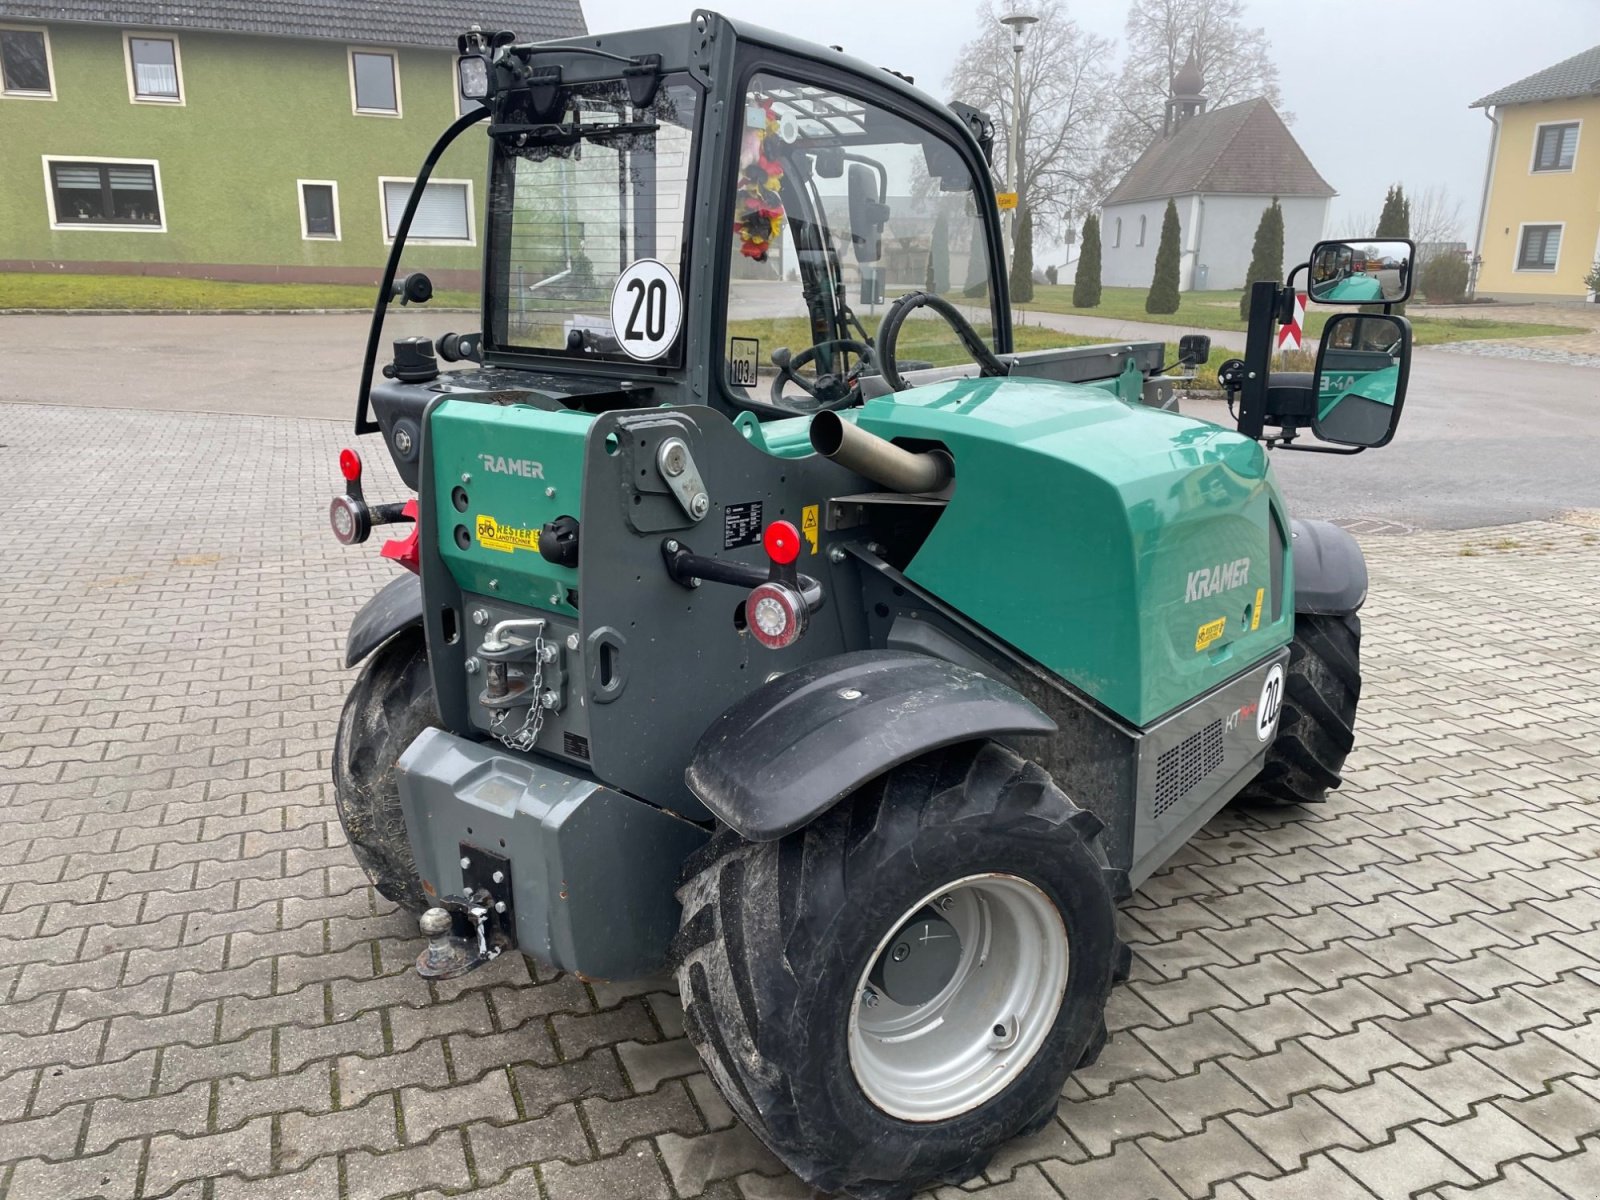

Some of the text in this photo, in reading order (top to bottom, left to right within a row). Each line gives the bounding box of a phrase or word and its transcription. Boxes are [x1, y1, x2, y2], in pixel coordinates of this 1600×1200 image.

[624, 278, 667, 342] 20
[733, 359, 749, 383] 103
[478, 453, 545, 480] RAMER
[1184, 557, 1250, 604] KRAMER
[1260, 677, 1279, 730] 20
